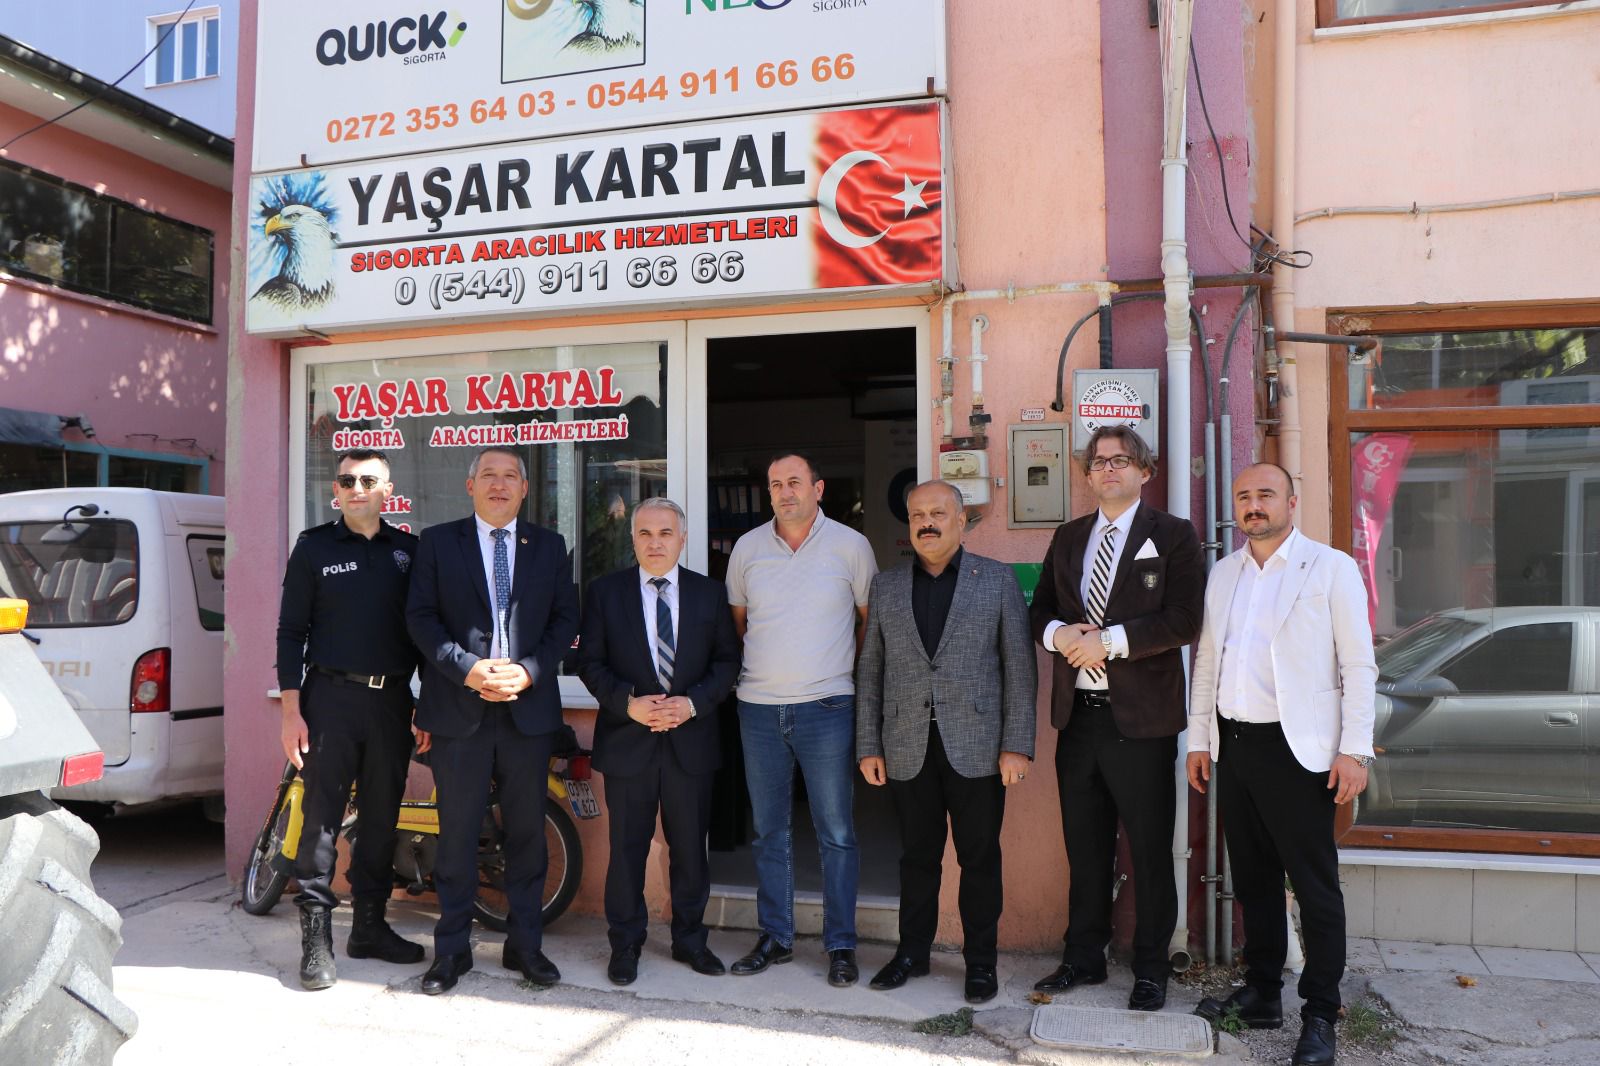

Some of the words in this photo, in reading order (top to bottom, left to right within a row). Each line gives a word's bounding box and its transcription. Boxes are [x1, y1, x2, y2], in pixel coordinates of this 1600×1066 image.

[316, 11, 447, 66] QUICK
[326, 112, 396, 143] 0272
[405, 103, 459, 132] 353
[470, 97, 507, 124] 64
[518, 90, 556, 118] 03
[587, 75, 668, 109] 0544
[679, 66, 739, 97] 911
[755, 60, 798, 88] 66
[811, 53, 855, 83] 66
[348, 158, 532, 233] YAŞAR
[554, 131, 805, 206] KARTAL
[473, 229, 606, 264] ARACILIK
[394, 277, 416, 305] 0
[429, 268, 525, 310] (544)
[538, 260, 608, 294] 911
[626, 255, 677, 288] 66
[691, 251, 744, 284] 66
[333, 377, 450, 427] YAŞAR
[465, 367, 622, 413] KARTAL
[1080, 405, 1142, 417] ESNAFINA
[430, 424, 516, 446] ARACILIK
